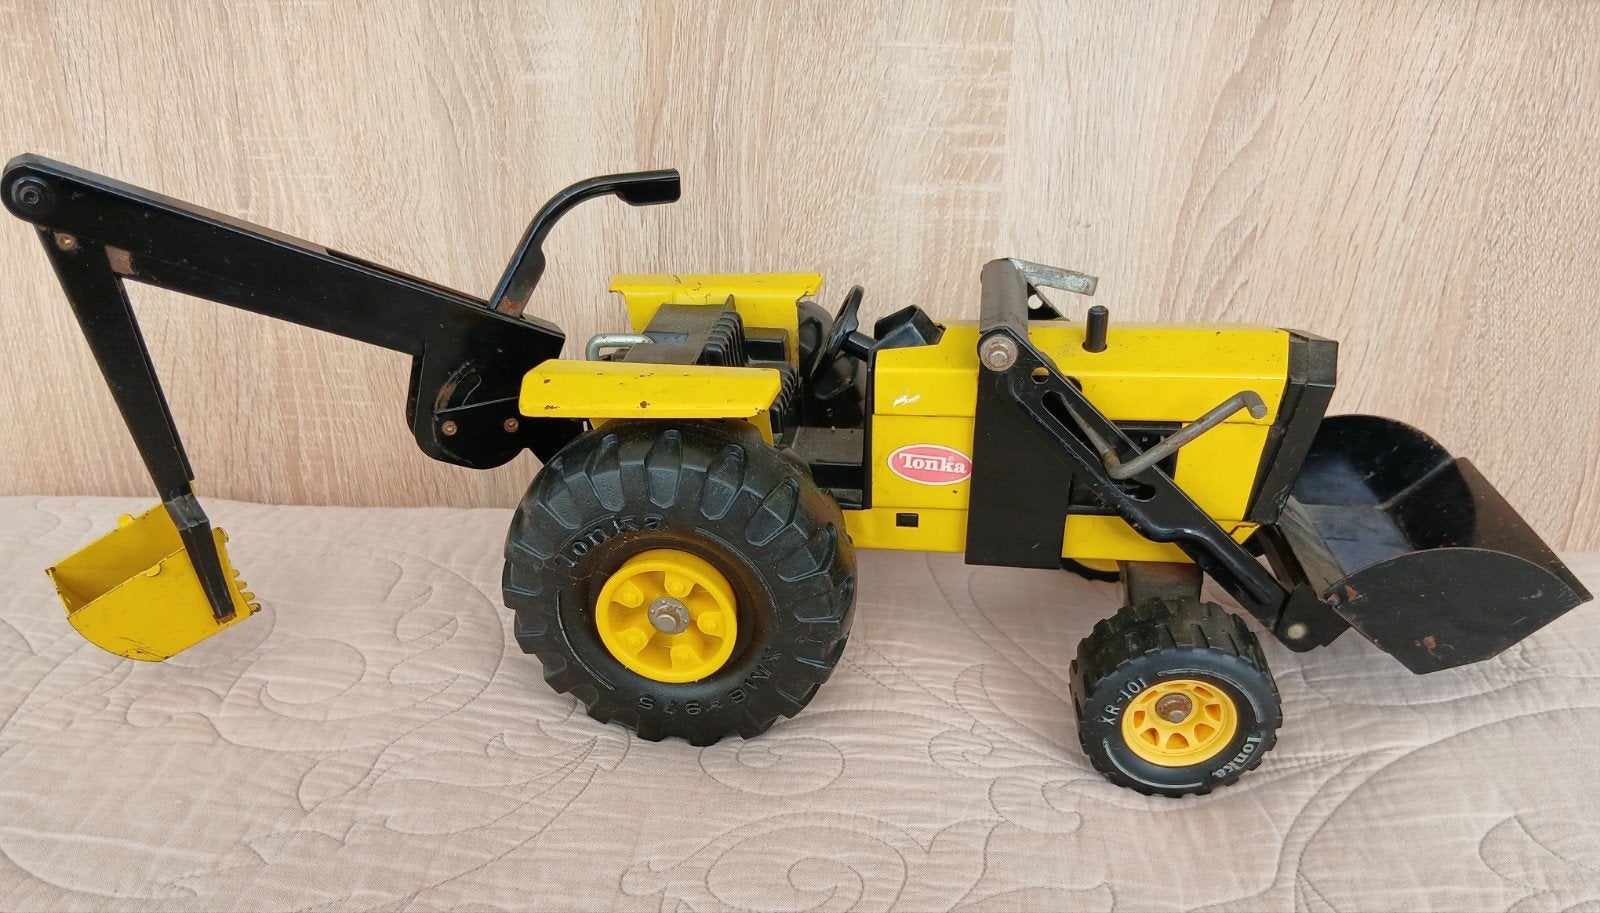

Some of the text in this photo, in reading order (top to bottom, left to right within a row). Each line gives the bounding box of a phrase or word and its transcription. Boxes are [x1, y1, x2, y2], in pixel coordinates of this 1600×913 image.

[898, 452, 967, 474] Tonka
[559, 514, 670, 568] Tonka
[1100, 676, 1148, 726] XR-101
[1212, 734, 1263, 778] Tonka
